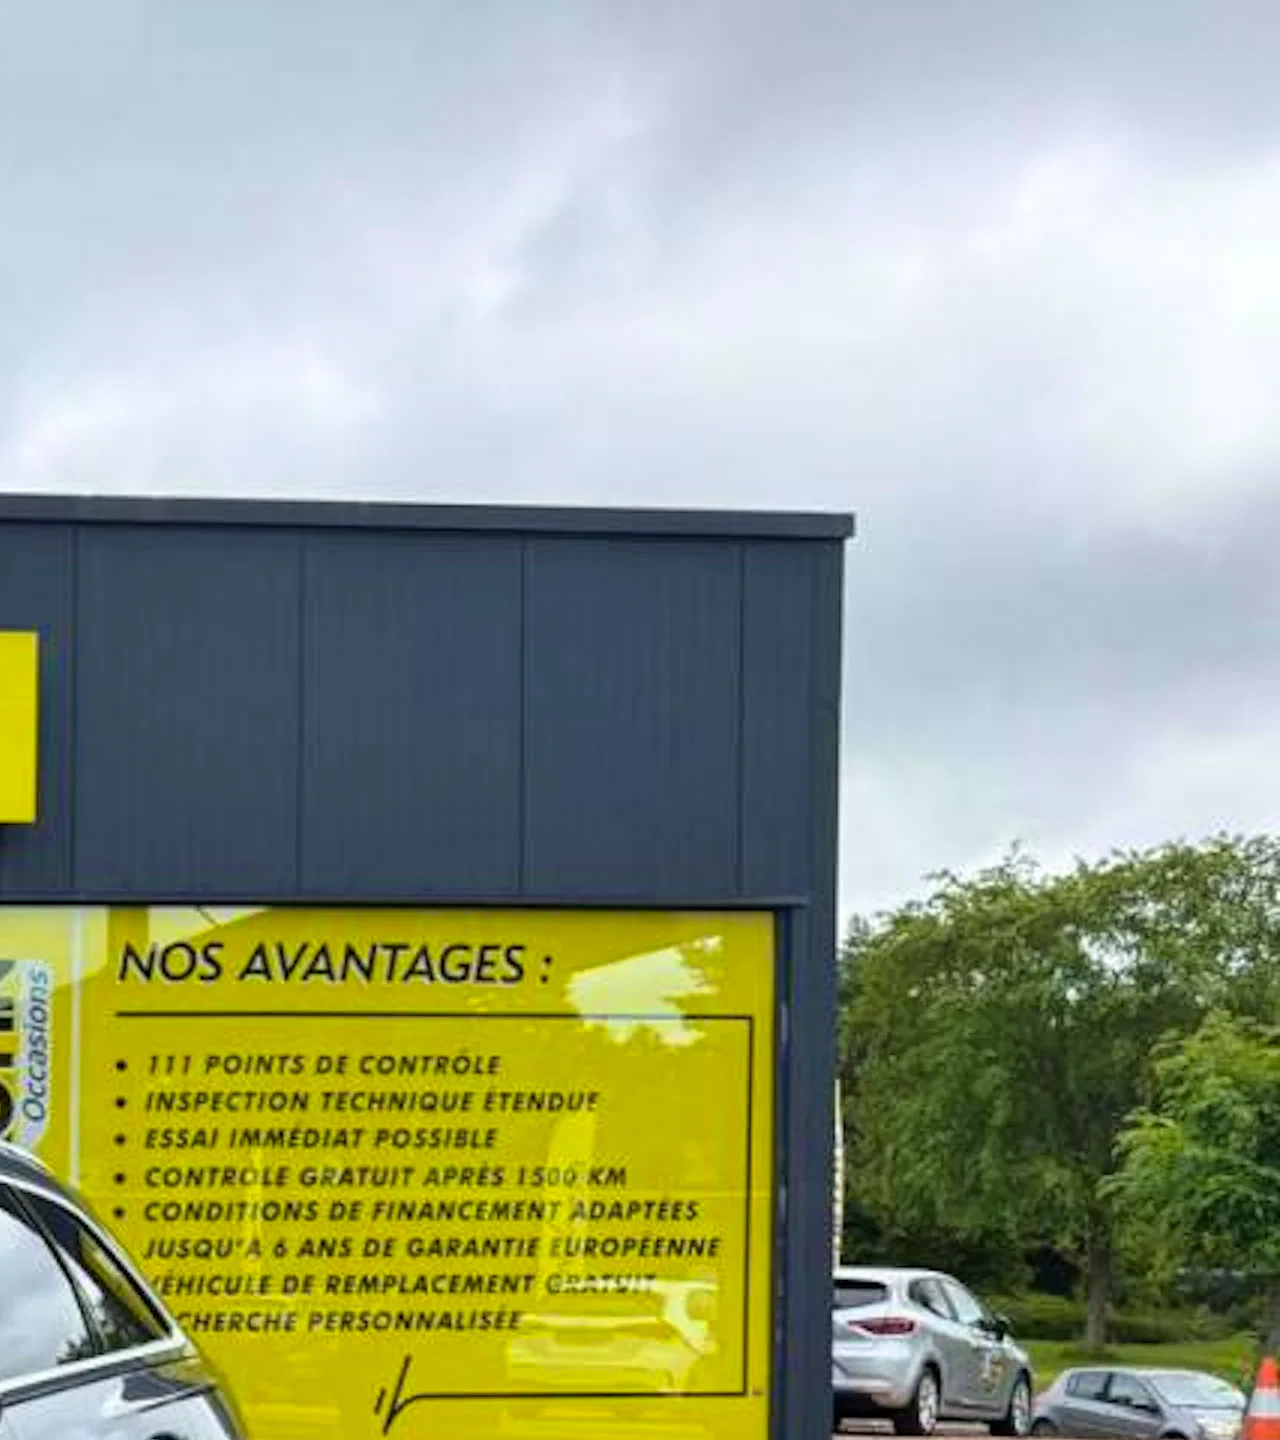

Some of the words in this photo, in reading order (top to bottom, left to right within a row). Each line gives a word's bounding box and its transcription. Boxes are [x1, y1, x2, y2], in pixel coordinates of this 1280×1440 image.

[118, 942, 225, 982] NOS
[239, 943, 526, 985] AVANTAGES
[23, 966, 49, 1121] Occasions
[149, 1055, 192, 1075] 111
[205, 1055, 305, 1075] POINTS
[316, 1055, 350, 1075] DE
[359, 1047, 502, 1075] CONTRÔLE
[145, 1092, 310, 1113] INSPECTION
[321, 1092, 475, 1113] TECHNIQUE
[144, 1128, 219, 1149] ESSAI
[229, 1122, 366, 1149] IMMÉDIAT
[374, 1128, 498, 1149] POSSIBLE
[299, 1167, 417, 1187] GRATUIT
[587, 1166, 628, 1187] KM
[144, 1201, 320, 1222] CONDITIONS
[328, 1202, 363, 1221] DE
[372, 1202, 562, 1222] FINANCEMENT
[272, 1237, 287, 1258] 6
[296, 1238, 353, 1259] ANS
[362, 1238, 397, 1258] DE
[405, 1238, 540, 1259] GARANTIE
[282, 1275, 316, 1295] DE
[324, 1274, 538, 1295] REMPLACEMENT
